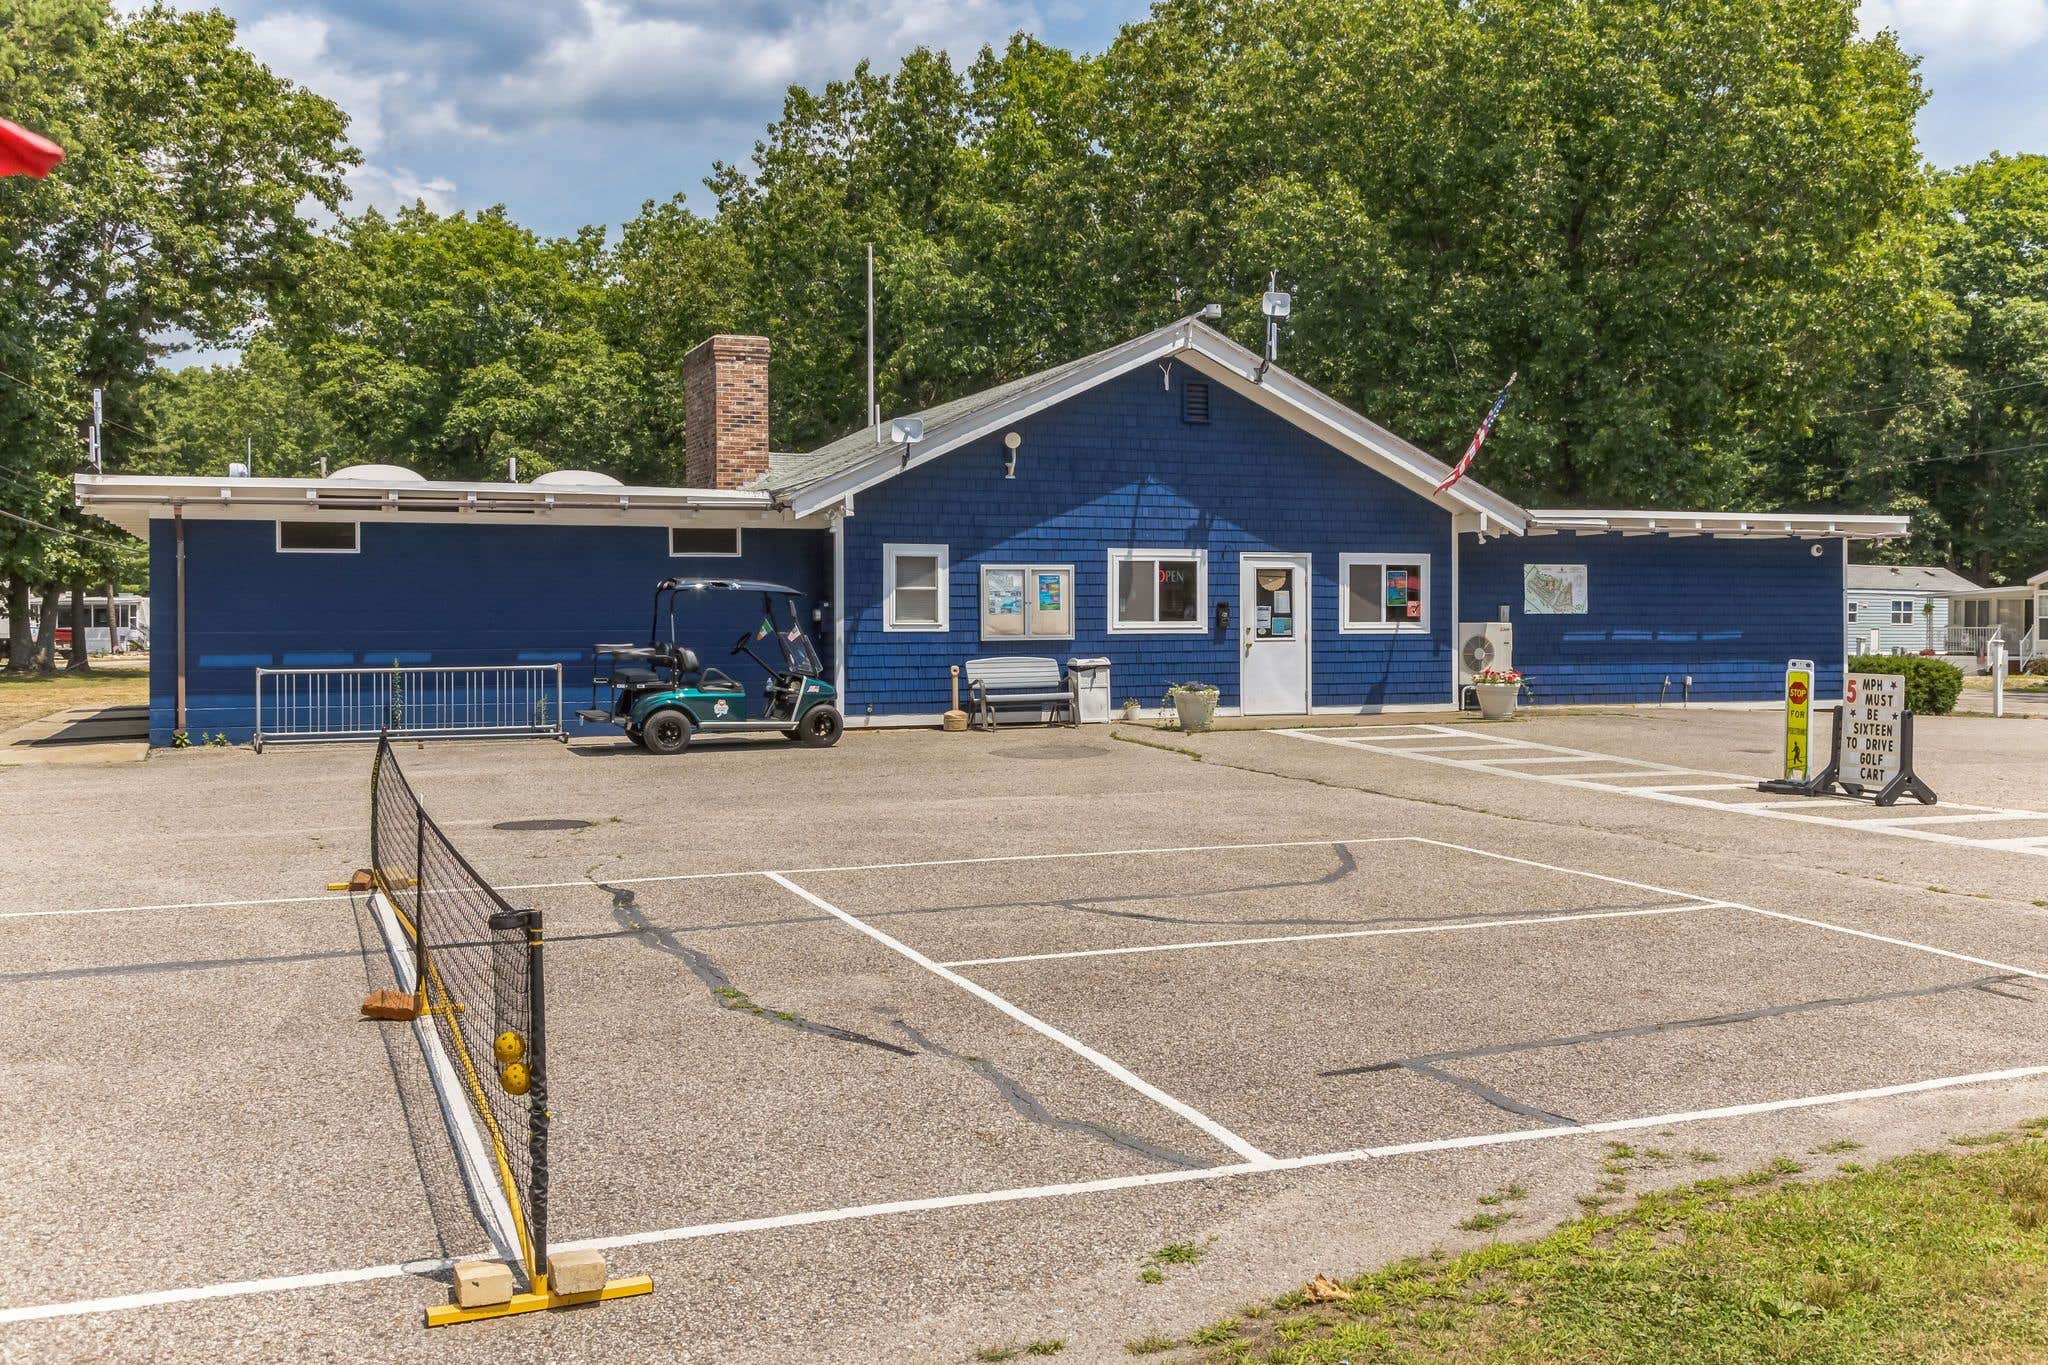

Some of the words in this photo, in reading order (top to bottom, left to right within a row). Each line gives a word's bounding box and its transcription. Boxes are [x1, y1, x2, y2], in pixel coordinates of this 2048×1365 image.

[1790, 689, 1807, 697] STOP
[1847, 679, 1857, 703] 5
[1862, 679, 1883, 691] MPH
[1865, 694, 1894, 707] MUST
[1790, 710, 1805, 719] FOR
[1867, 708, 1879, 721] BE
[1853, 722, 1893, 737] SIXTEEN
[1846, 736, 1858, 749] TO
[1865, 738, 1894, 752] DRIVE
[1860, 753, 1883, 766] GOLF
[1860, 767, 1885, 781] CART
